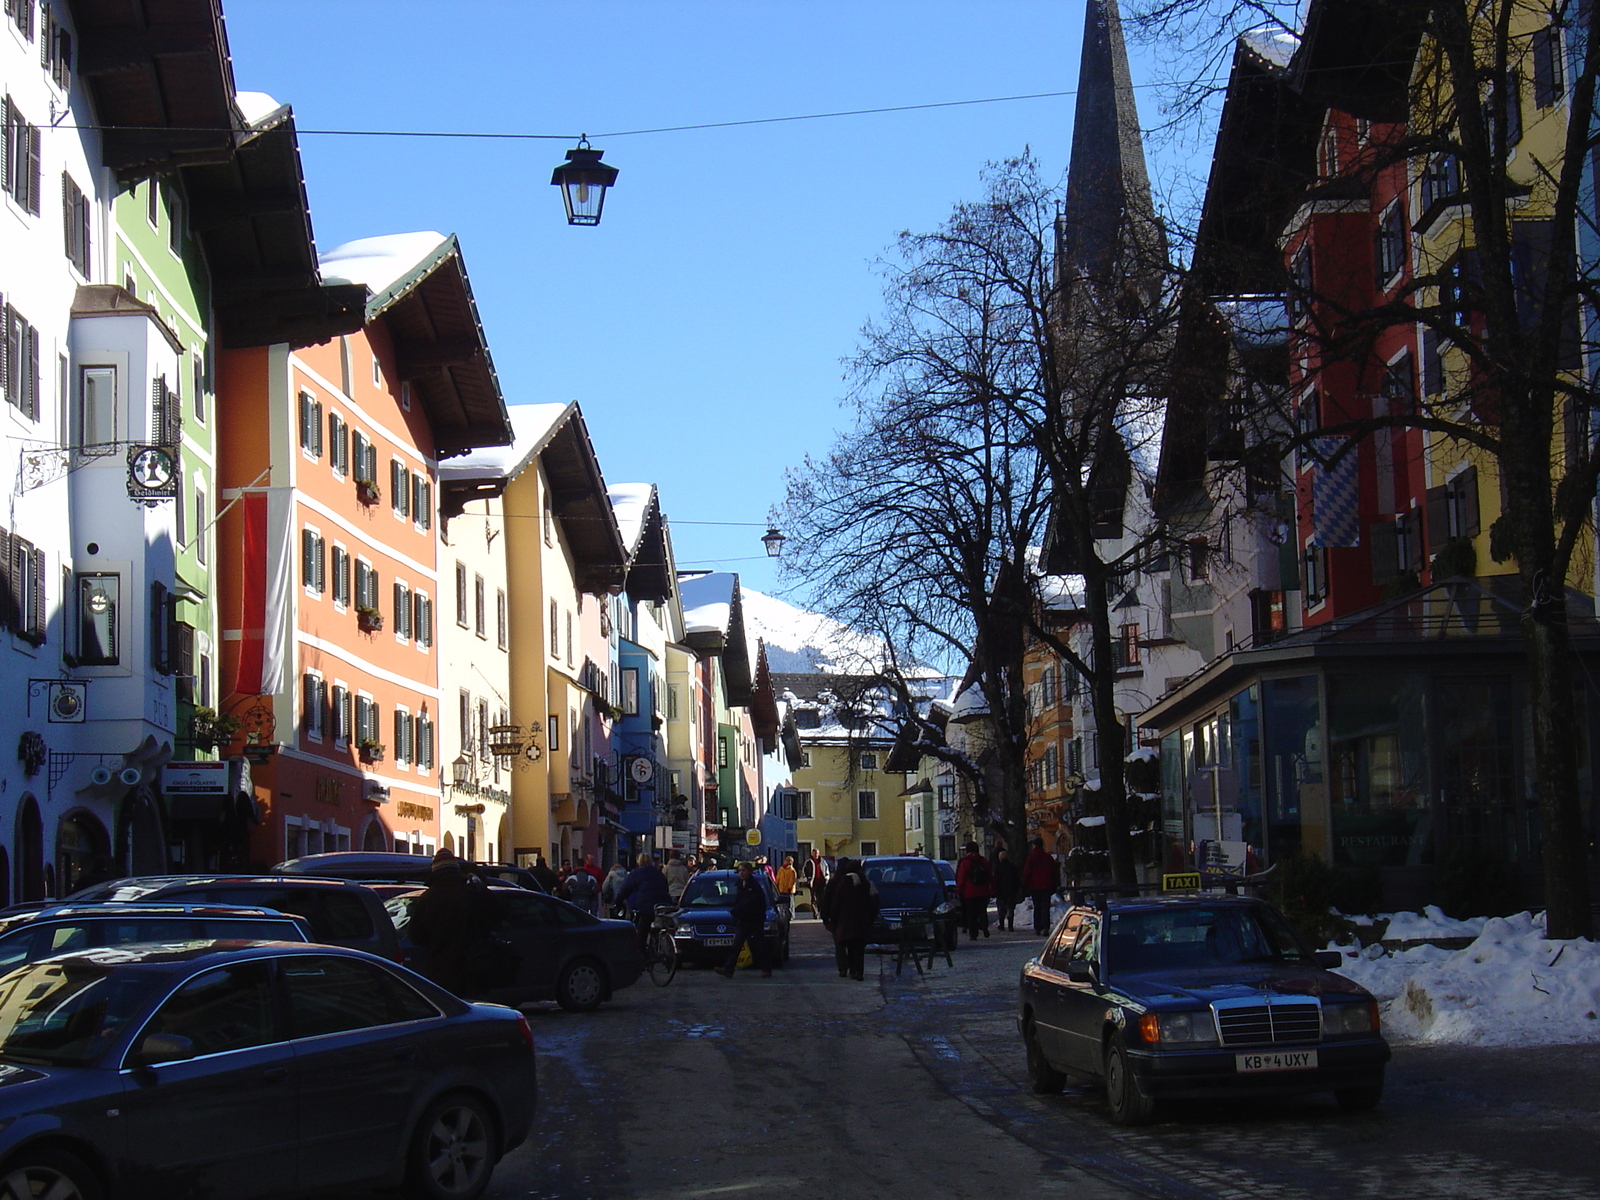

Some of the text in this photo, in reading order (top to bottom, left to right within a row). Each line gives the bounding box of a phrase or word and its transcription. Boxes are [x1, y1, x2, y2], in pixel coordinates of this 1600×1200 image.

[1340, 834, 1425, 848] RESTAURANT
[1168, 876, 1197, 888] TAXI
[1244, 1053, 1309, 1069] KB 4 UXY
